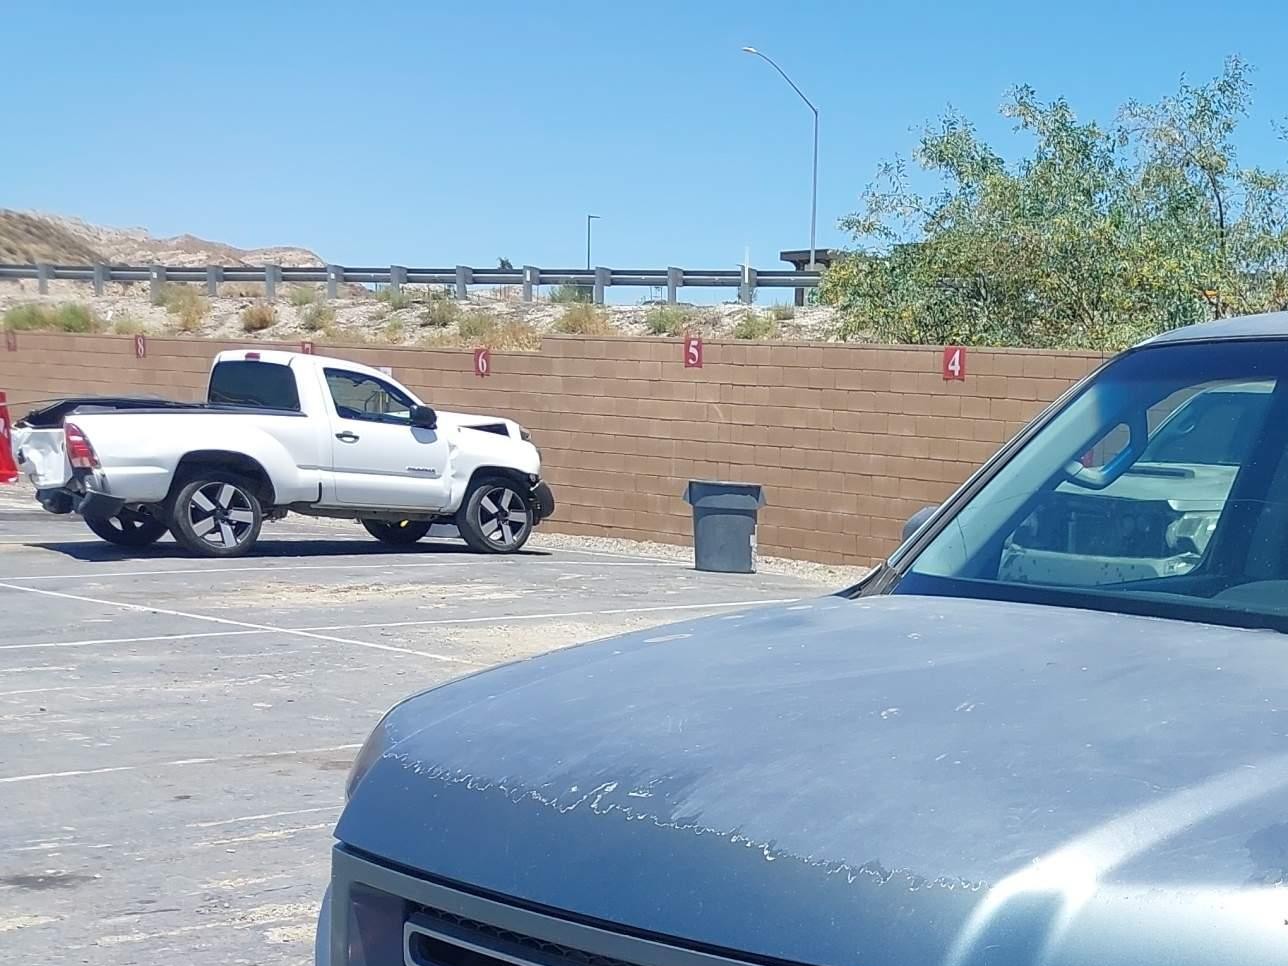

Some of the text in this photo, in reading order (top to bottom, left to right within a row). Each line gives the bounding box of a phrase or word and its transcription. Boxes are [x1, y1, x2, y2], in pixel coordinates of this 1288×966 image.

[137, 336, 144, 357] 8
[687, 339, 699, 364] 5
[477, 350, 487, 373] 6
[947, 349, 961, 377] 4
